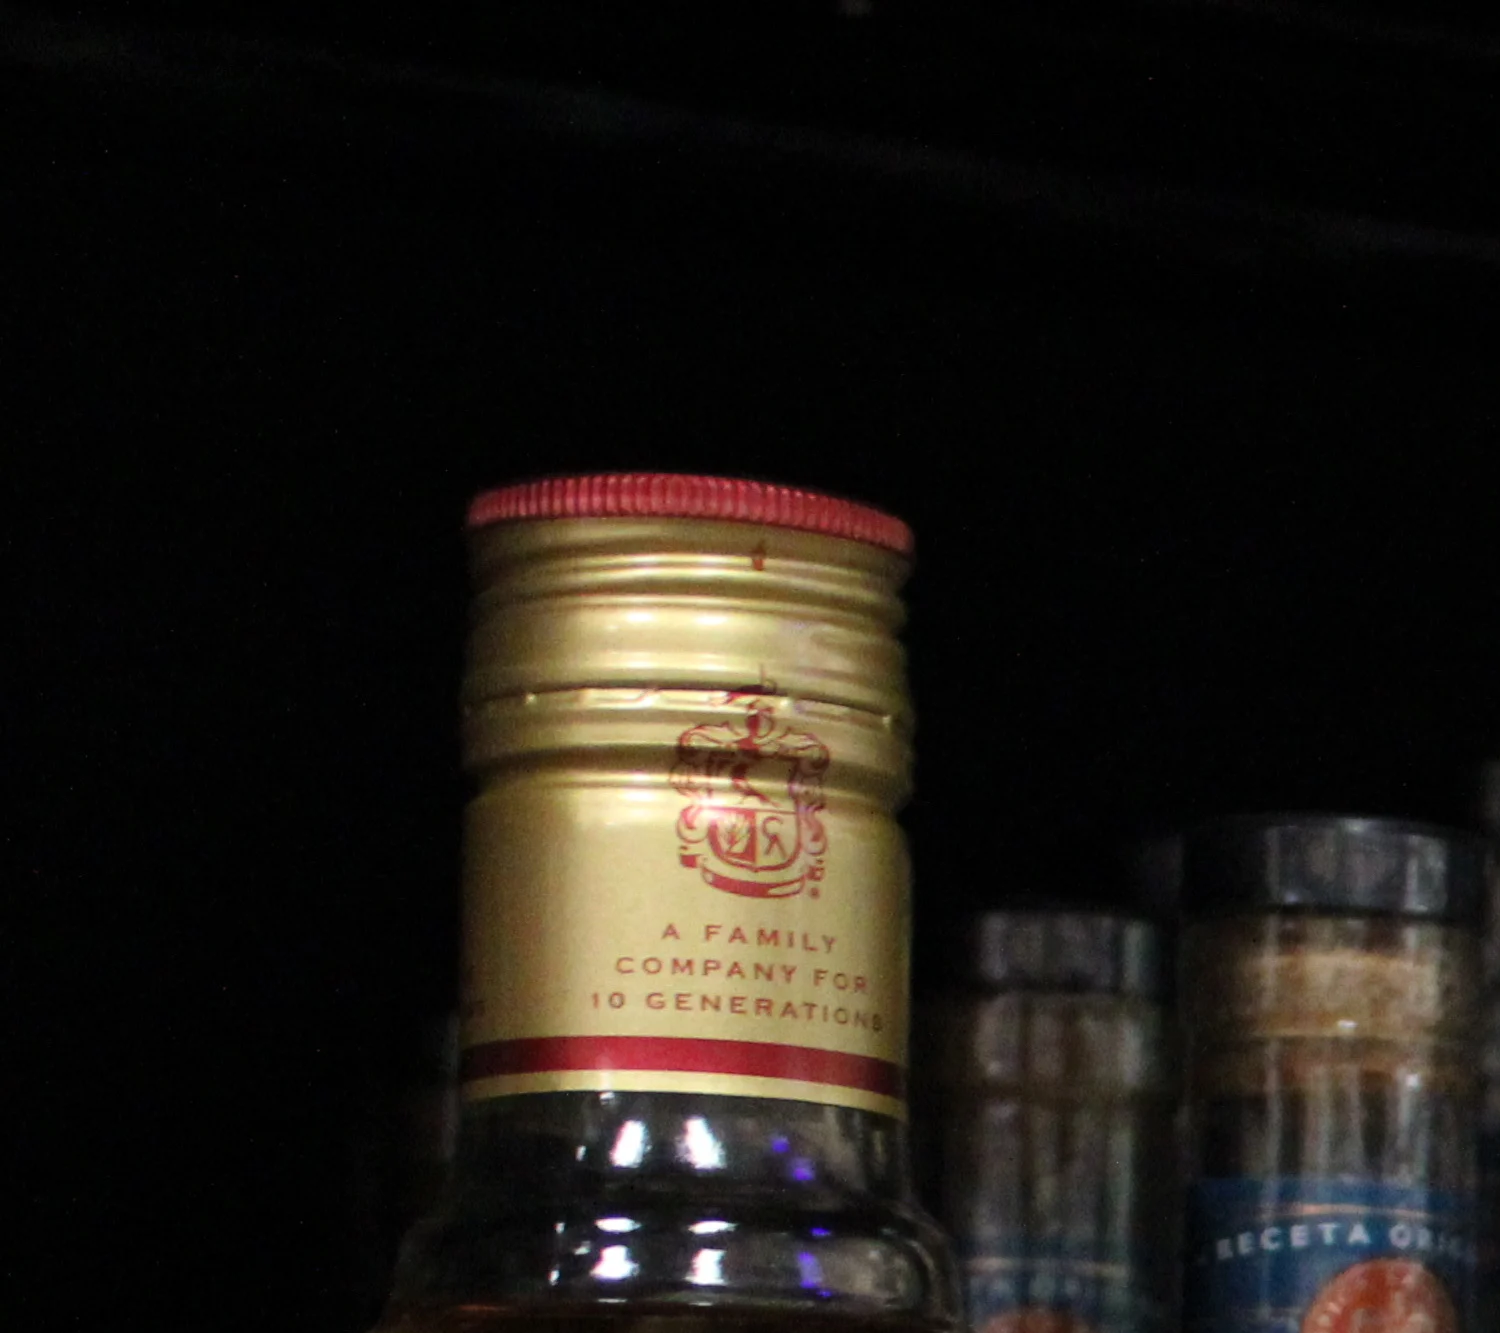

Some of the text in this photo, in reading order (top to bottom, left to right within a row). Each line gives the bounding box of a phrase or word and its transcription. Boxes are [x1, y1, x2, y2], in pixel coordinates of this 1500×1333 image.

[661, 923, 837, 954] A FAMILY
[615, 957, 869, 995] COMPANY FOR
[591, 992, 885, 1034] 10 GENERATIONS
